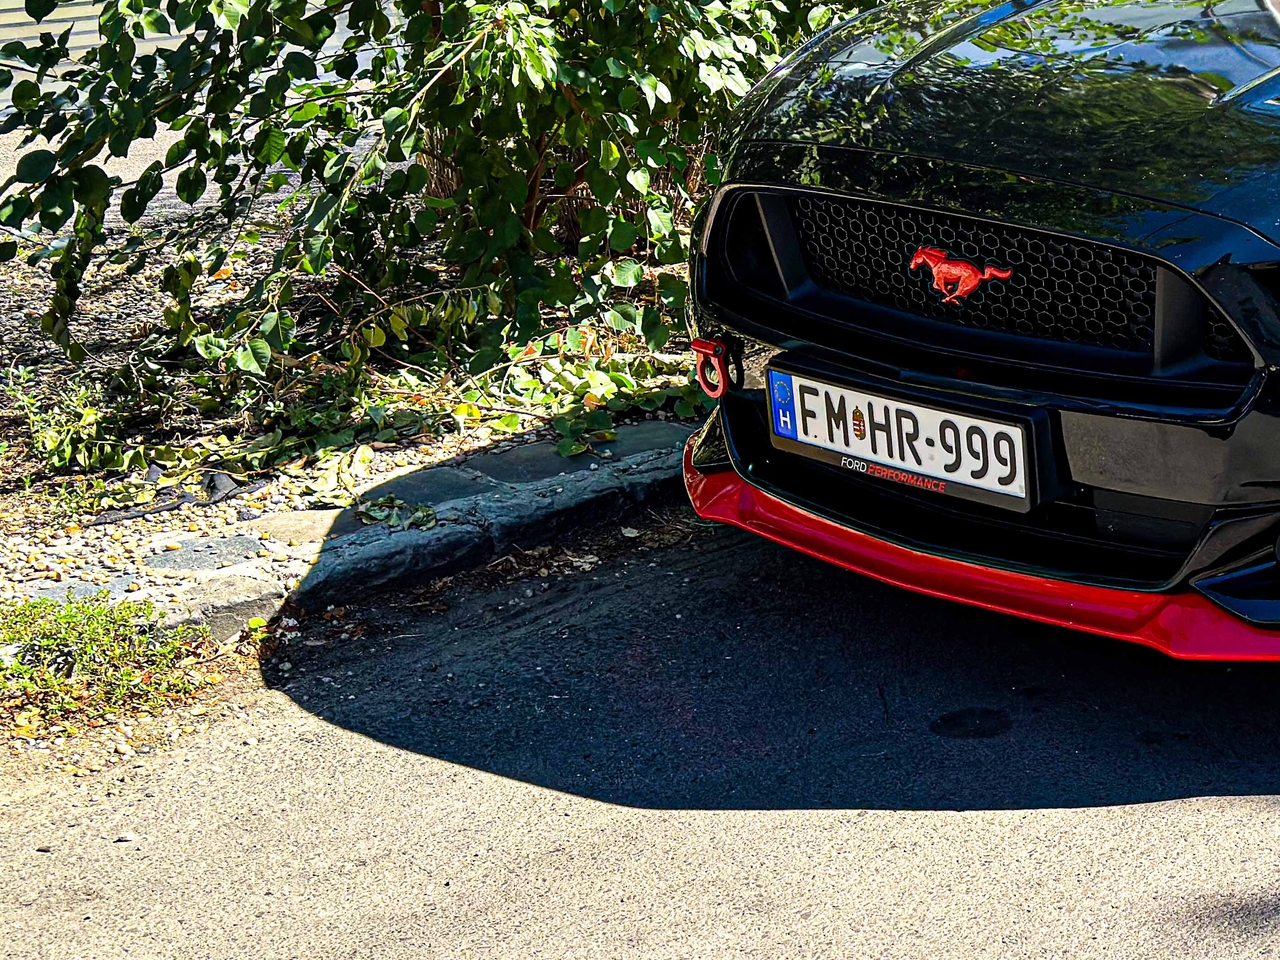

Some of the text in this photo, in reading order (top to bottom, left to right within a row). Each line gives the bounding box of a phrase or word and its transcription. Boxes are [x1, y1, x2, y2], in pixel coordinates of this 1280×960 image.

[778, 408, 791, 430] H
[841, 456, 947, 493] FORD PERFORMANCE
